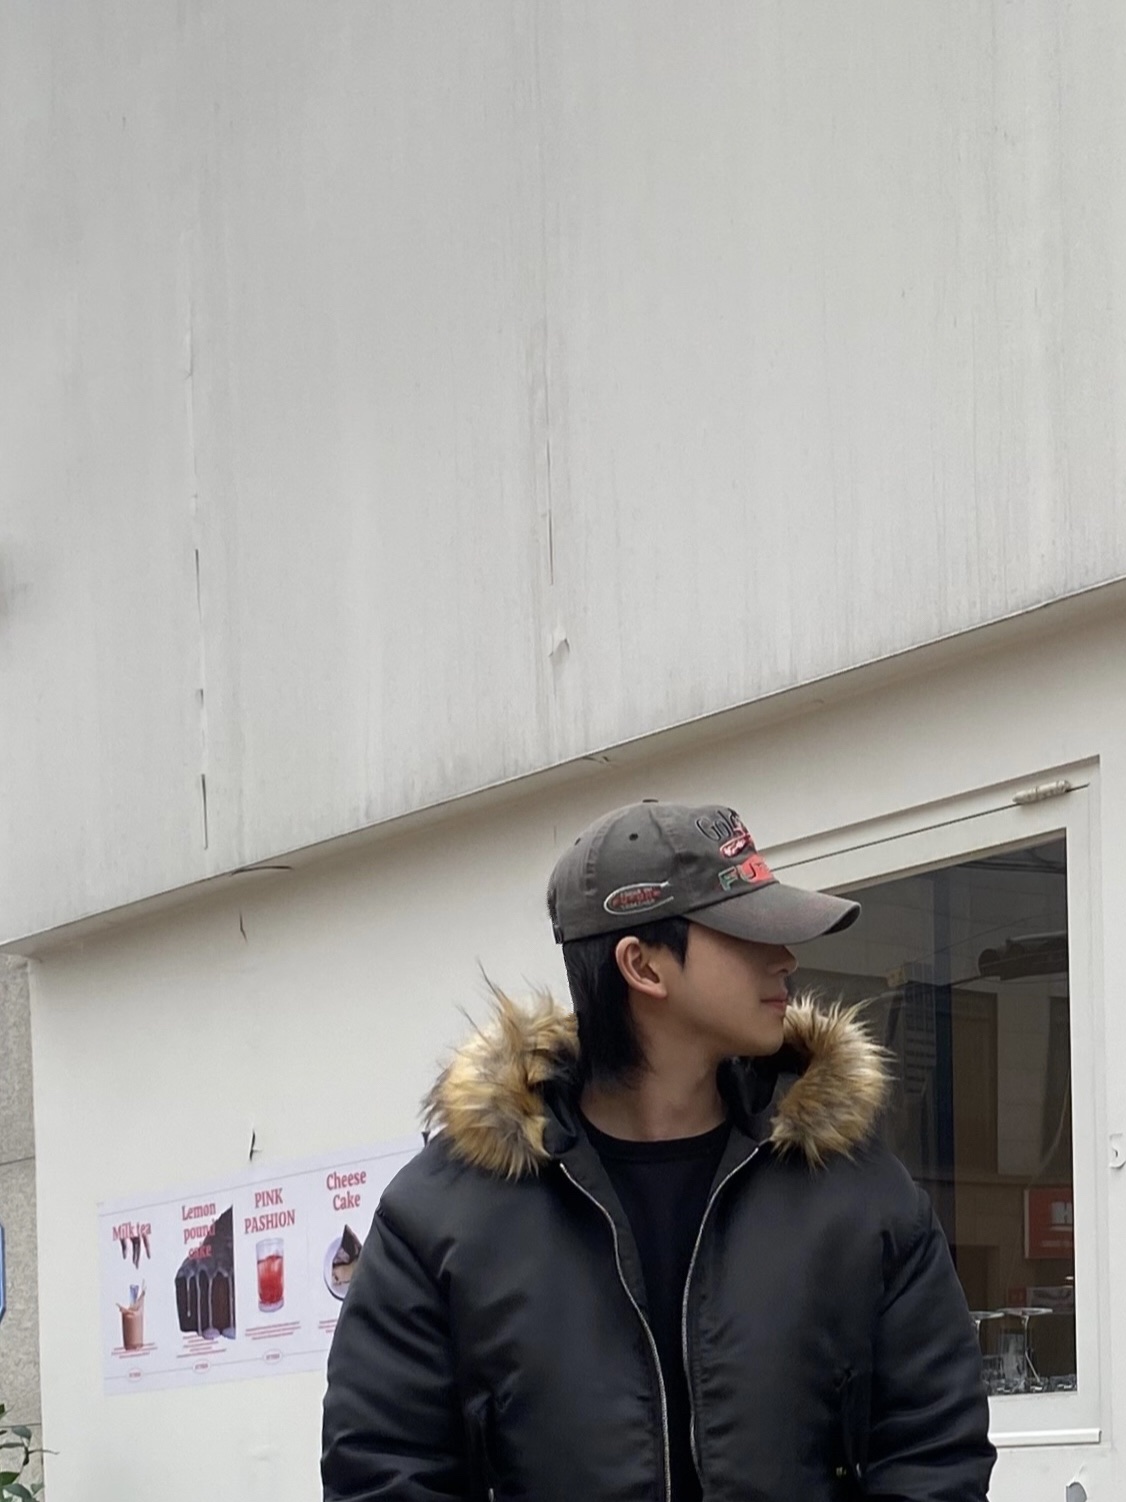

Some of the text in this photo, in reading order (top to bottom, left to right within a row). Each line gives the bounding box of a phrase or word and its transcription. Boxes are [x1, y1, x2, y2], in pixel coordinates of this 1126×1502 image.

[326, 1170, 367, 1191] Cheese
[254, 1187, 284, 1209] PINK
[332, 1190, 361, 1212] Cake
[181, 1203, 217, 1221] Lemon
[244, 1208, 296, 1235] PASHION
[112, 1221, 152, 1241] Milk tea
[183, 1218, 216, 1245] pound
[188, 1241, 213, 1259] cake
